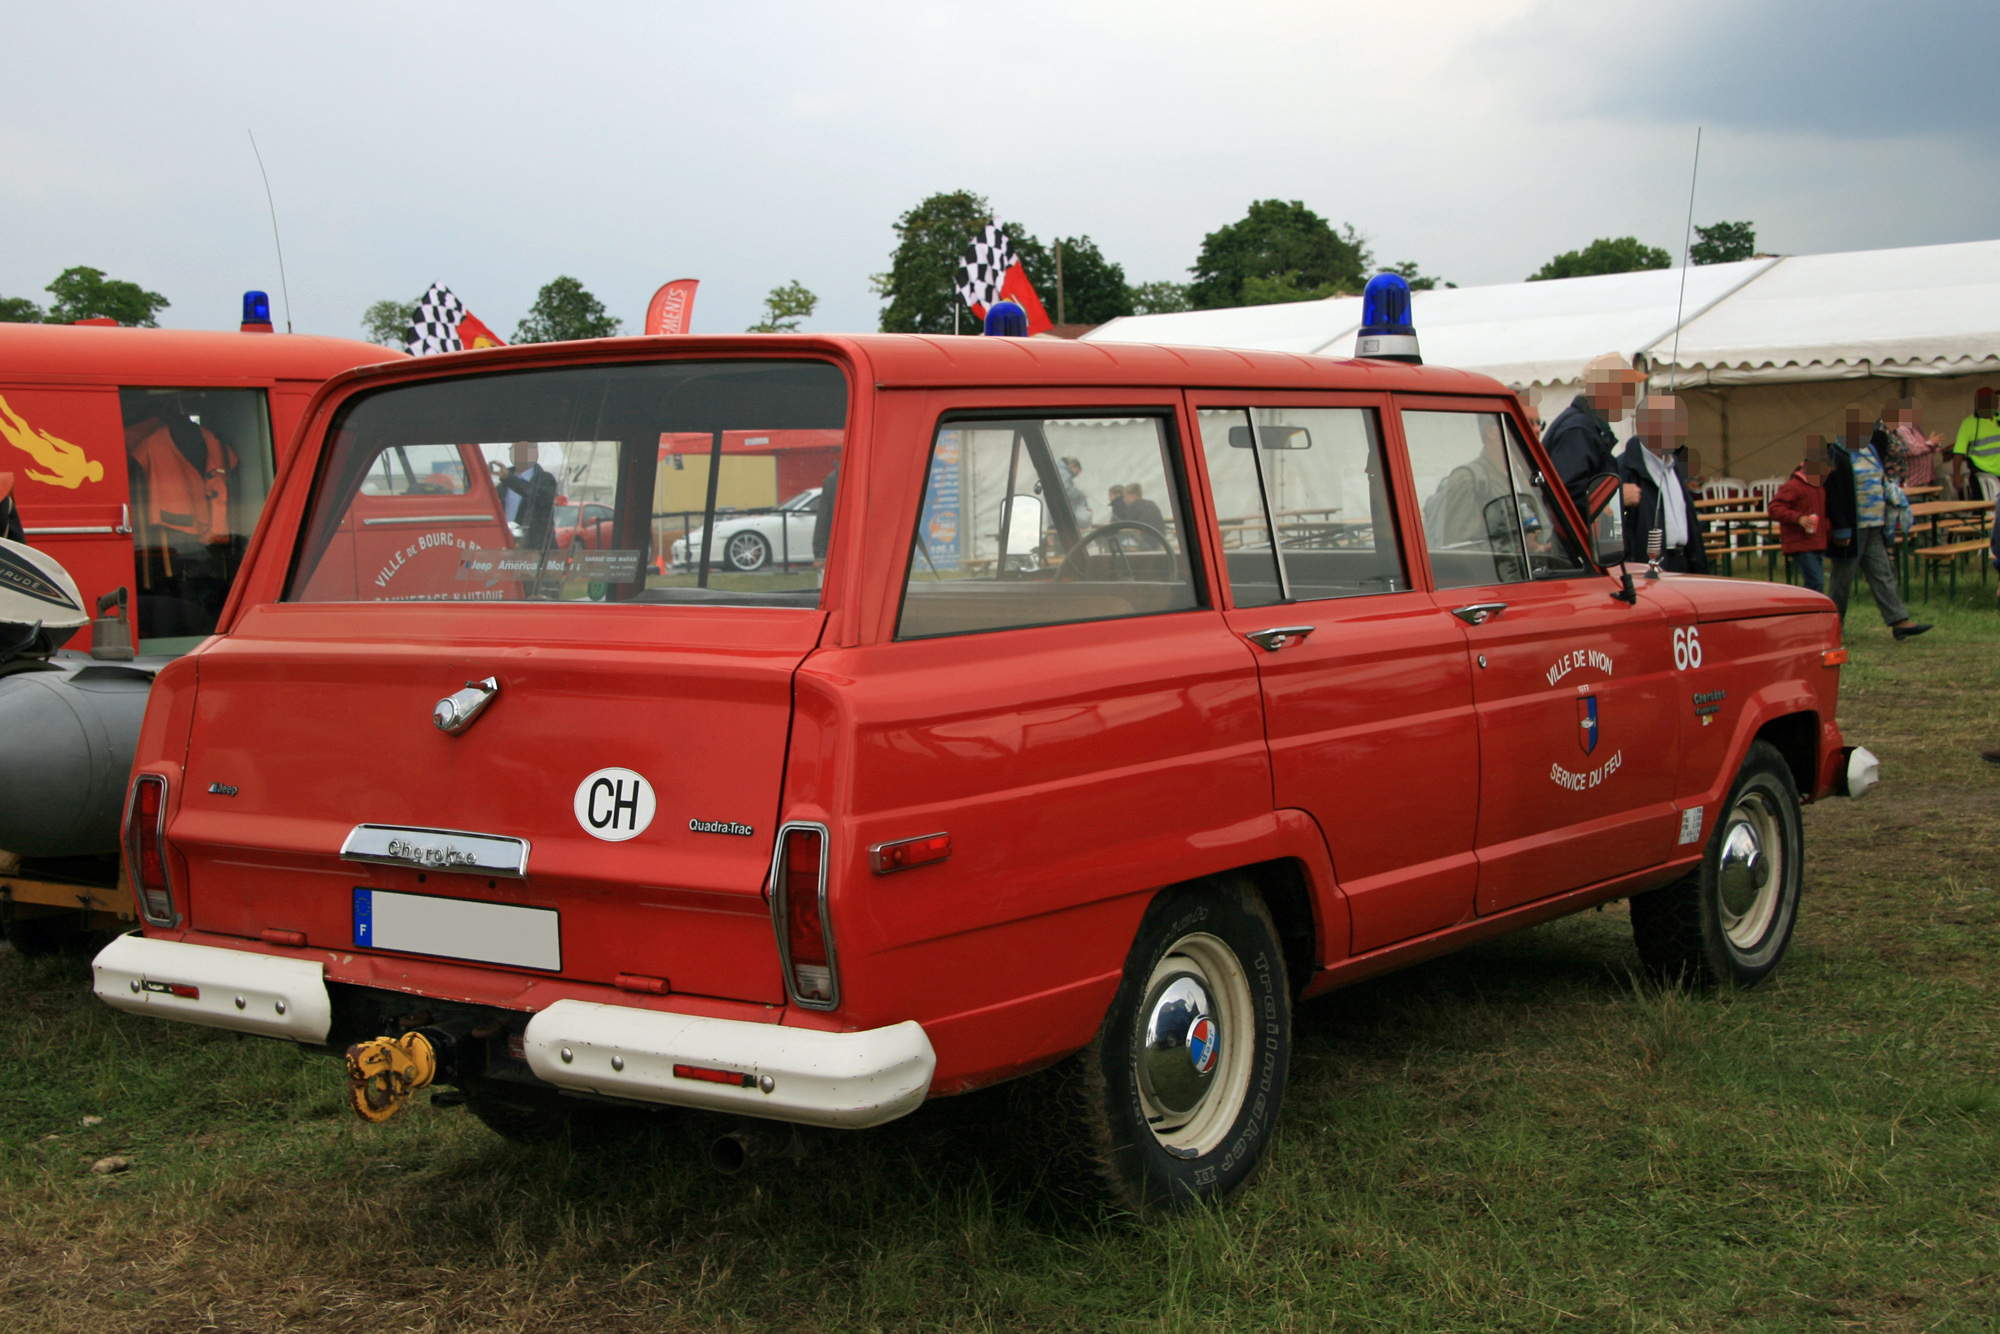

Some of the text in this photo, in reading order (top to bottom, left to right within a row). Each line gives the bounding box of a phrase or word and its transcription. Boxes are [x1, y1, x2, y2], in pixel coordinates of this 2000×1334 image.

[375, 551, 406, 588] VILLE
[406, 545, 418, 558] DE
[418, 532, 454, 550] BOURG
[457, 539, 466, 550] EN
[471, 560, 493, 572] Jeep
[498, 560, 543, 571] America
[1673, 626, 1702, 671] 66
[1546, 649, 1613, 686] VILLE DE NYON
[1550, 749, 1622, 792] SERVICE DU FEU
[216, 783, 238, 797] Jeep
[587, 777, 640, 831] CH
[388, 839, 477, 866] Cherokee
[359, 923, 367, 937] F
[1201, 1029, 1215, 1063] Jeep
